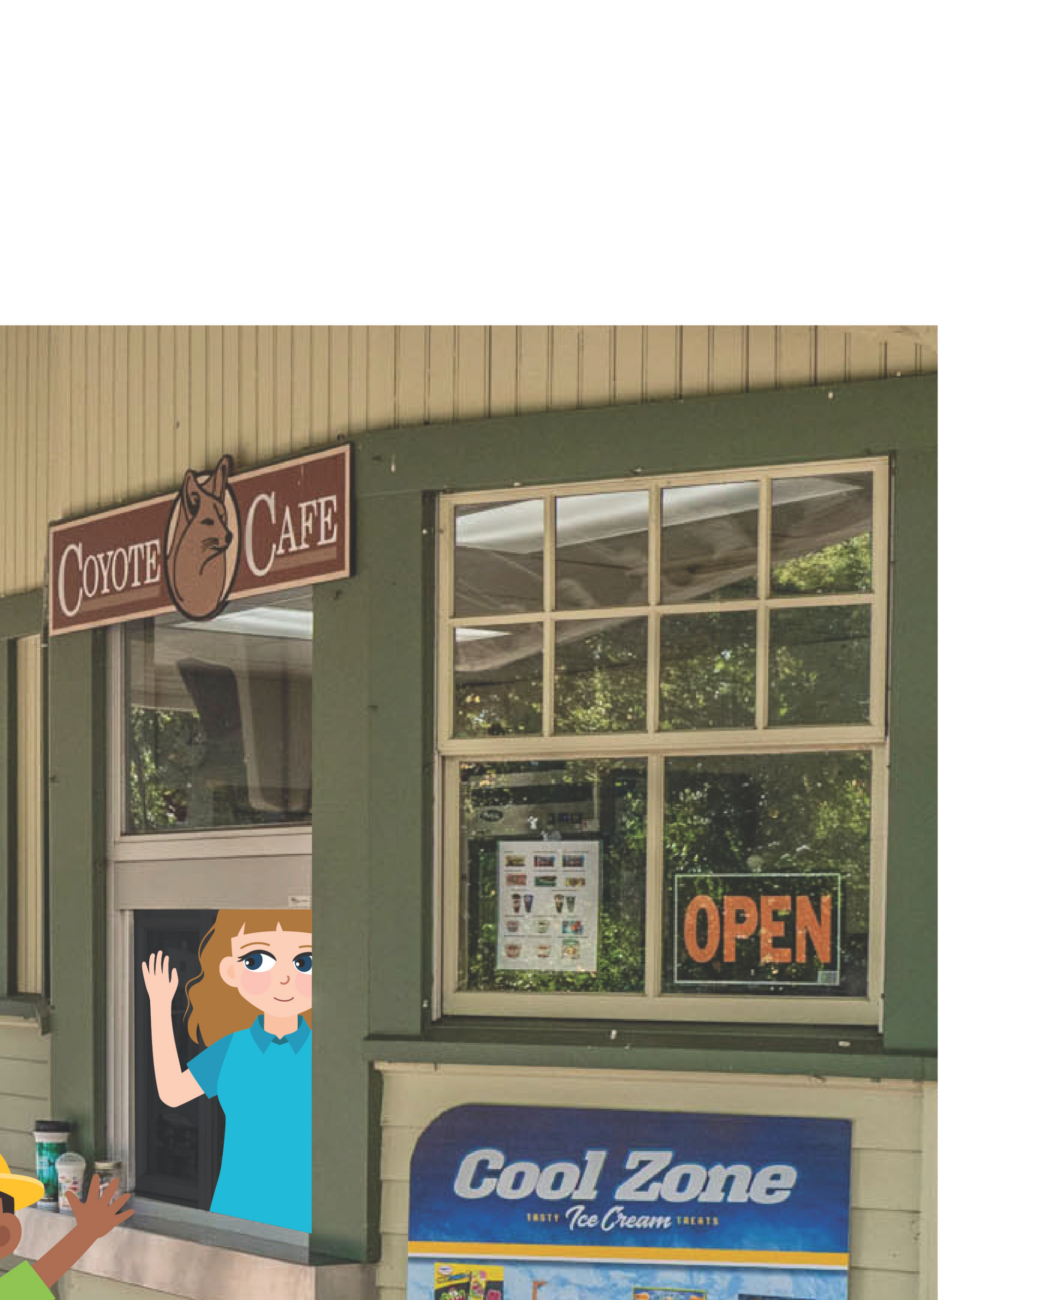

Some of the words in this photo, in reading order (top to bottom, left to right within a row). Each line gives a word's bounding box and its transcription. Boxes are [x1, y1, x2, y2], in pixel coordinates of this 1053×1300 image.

[57, 539, 161, 617] COYOTE
[245, 491, 338, 577] CAFE
[683, 894, 832, 963] OPEN
[453, 1148, 608, 1201] Cool
[614, 1150, 798, 1205] Zone
[565, 1204, 599, 1231] Ice
[601, 1205, 672, 1232] Cream
[676, 1216, 719, 1226] TREATS
